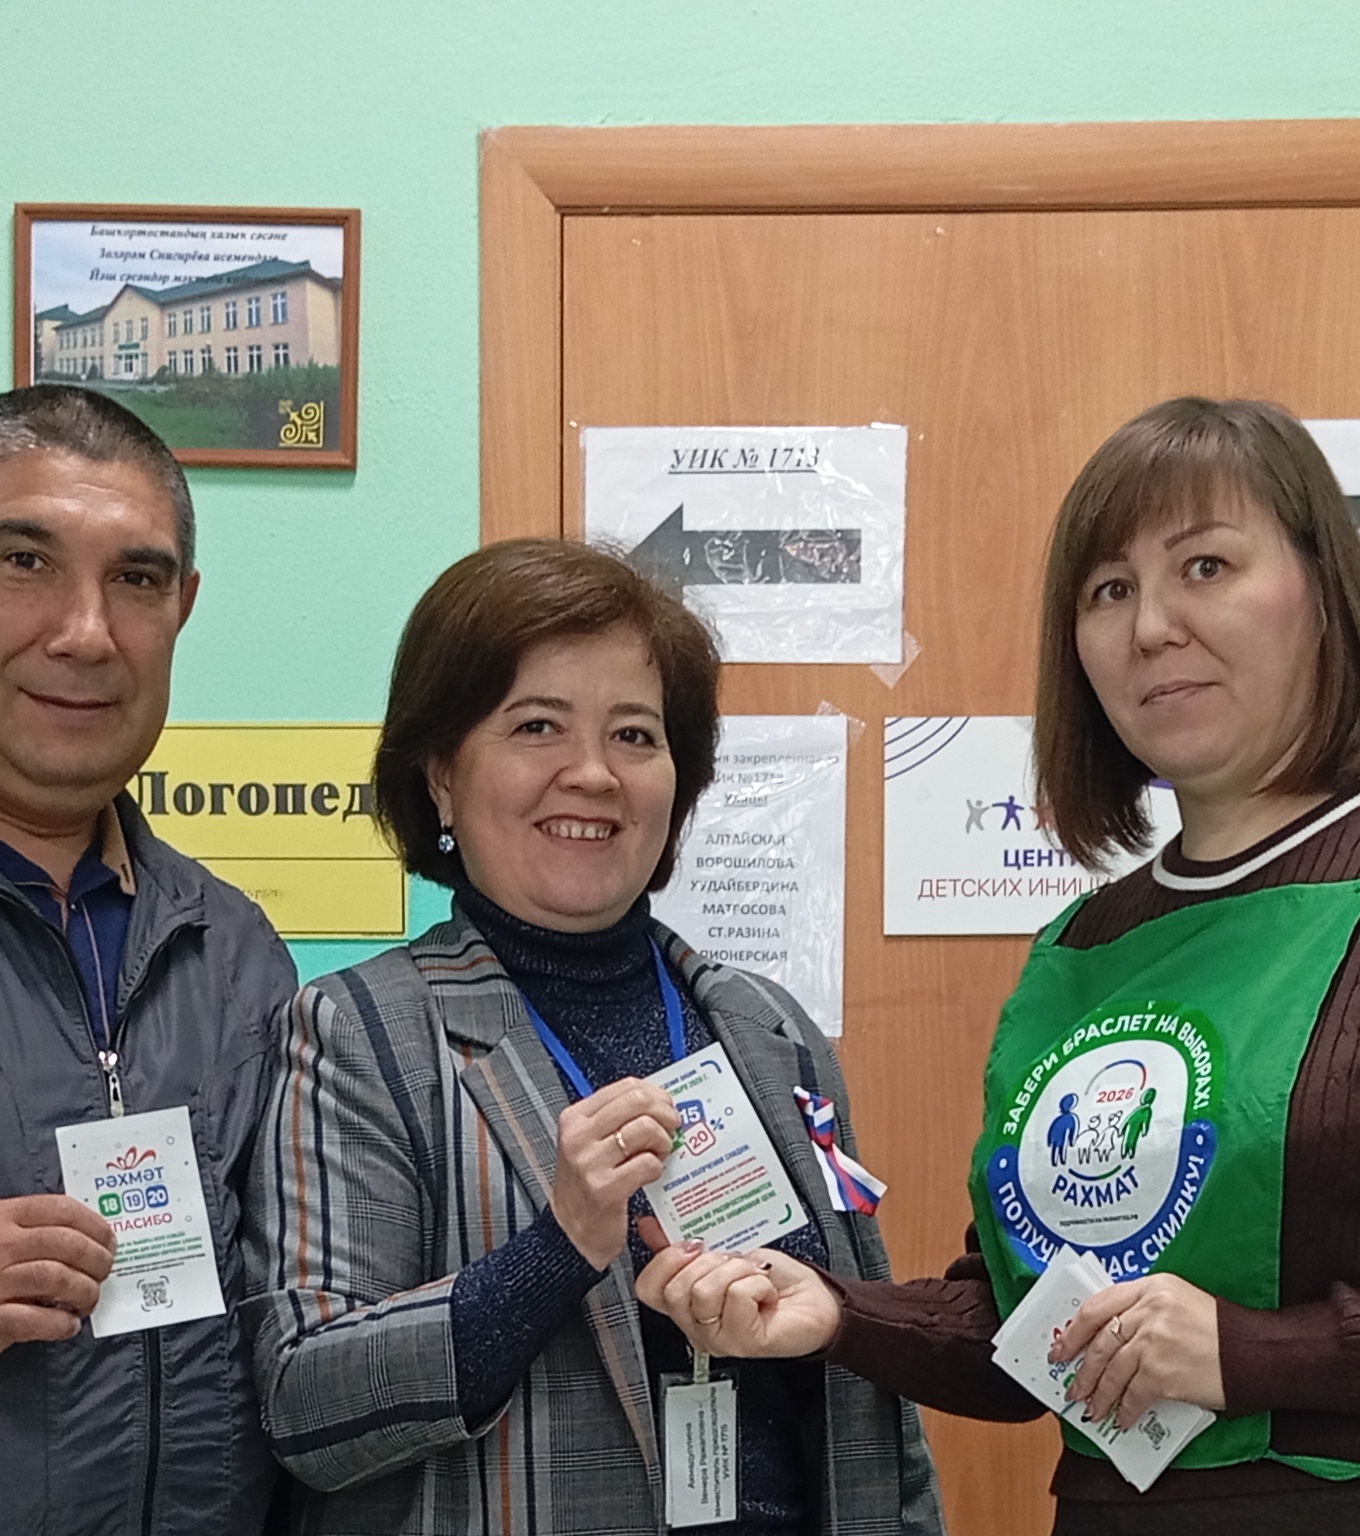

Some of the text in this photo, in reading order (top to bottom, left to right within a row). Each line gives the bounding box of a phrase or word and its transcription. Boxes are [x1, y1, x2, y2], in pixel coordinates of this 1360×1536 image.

[670, 448, 729, 469] УИК
[705, 832, 785, 845] АЛТАЙСКАЯ
[696, 857, 795, 869] ВОРОШИЛОВА
[1004, 849, 1076, 870] ЦЕНТ
[917, 878, 1022, 900] ДЕТСКИХ
[700, 949, 788, 962] ПИОНЕРСКАЯ
[1003, 1014, 1213, 1136] ЗАБЕРИ БРАСЛЕТ НА ВЫБОРАХ!
[1096, 1087, 1134, 1103] 2026
[689, 1130, 708, 1149] 20
[1051, 1165, 1139, 1208] РАХМАТ
[101, 1189, 166, 1213] 18 19 20
[110, 1213, 172, 1232] ПАСИБО
[1101, 1250, 1139, 1277] АС
[1142, 1155, 1205, 1262] СКИДКУ!
